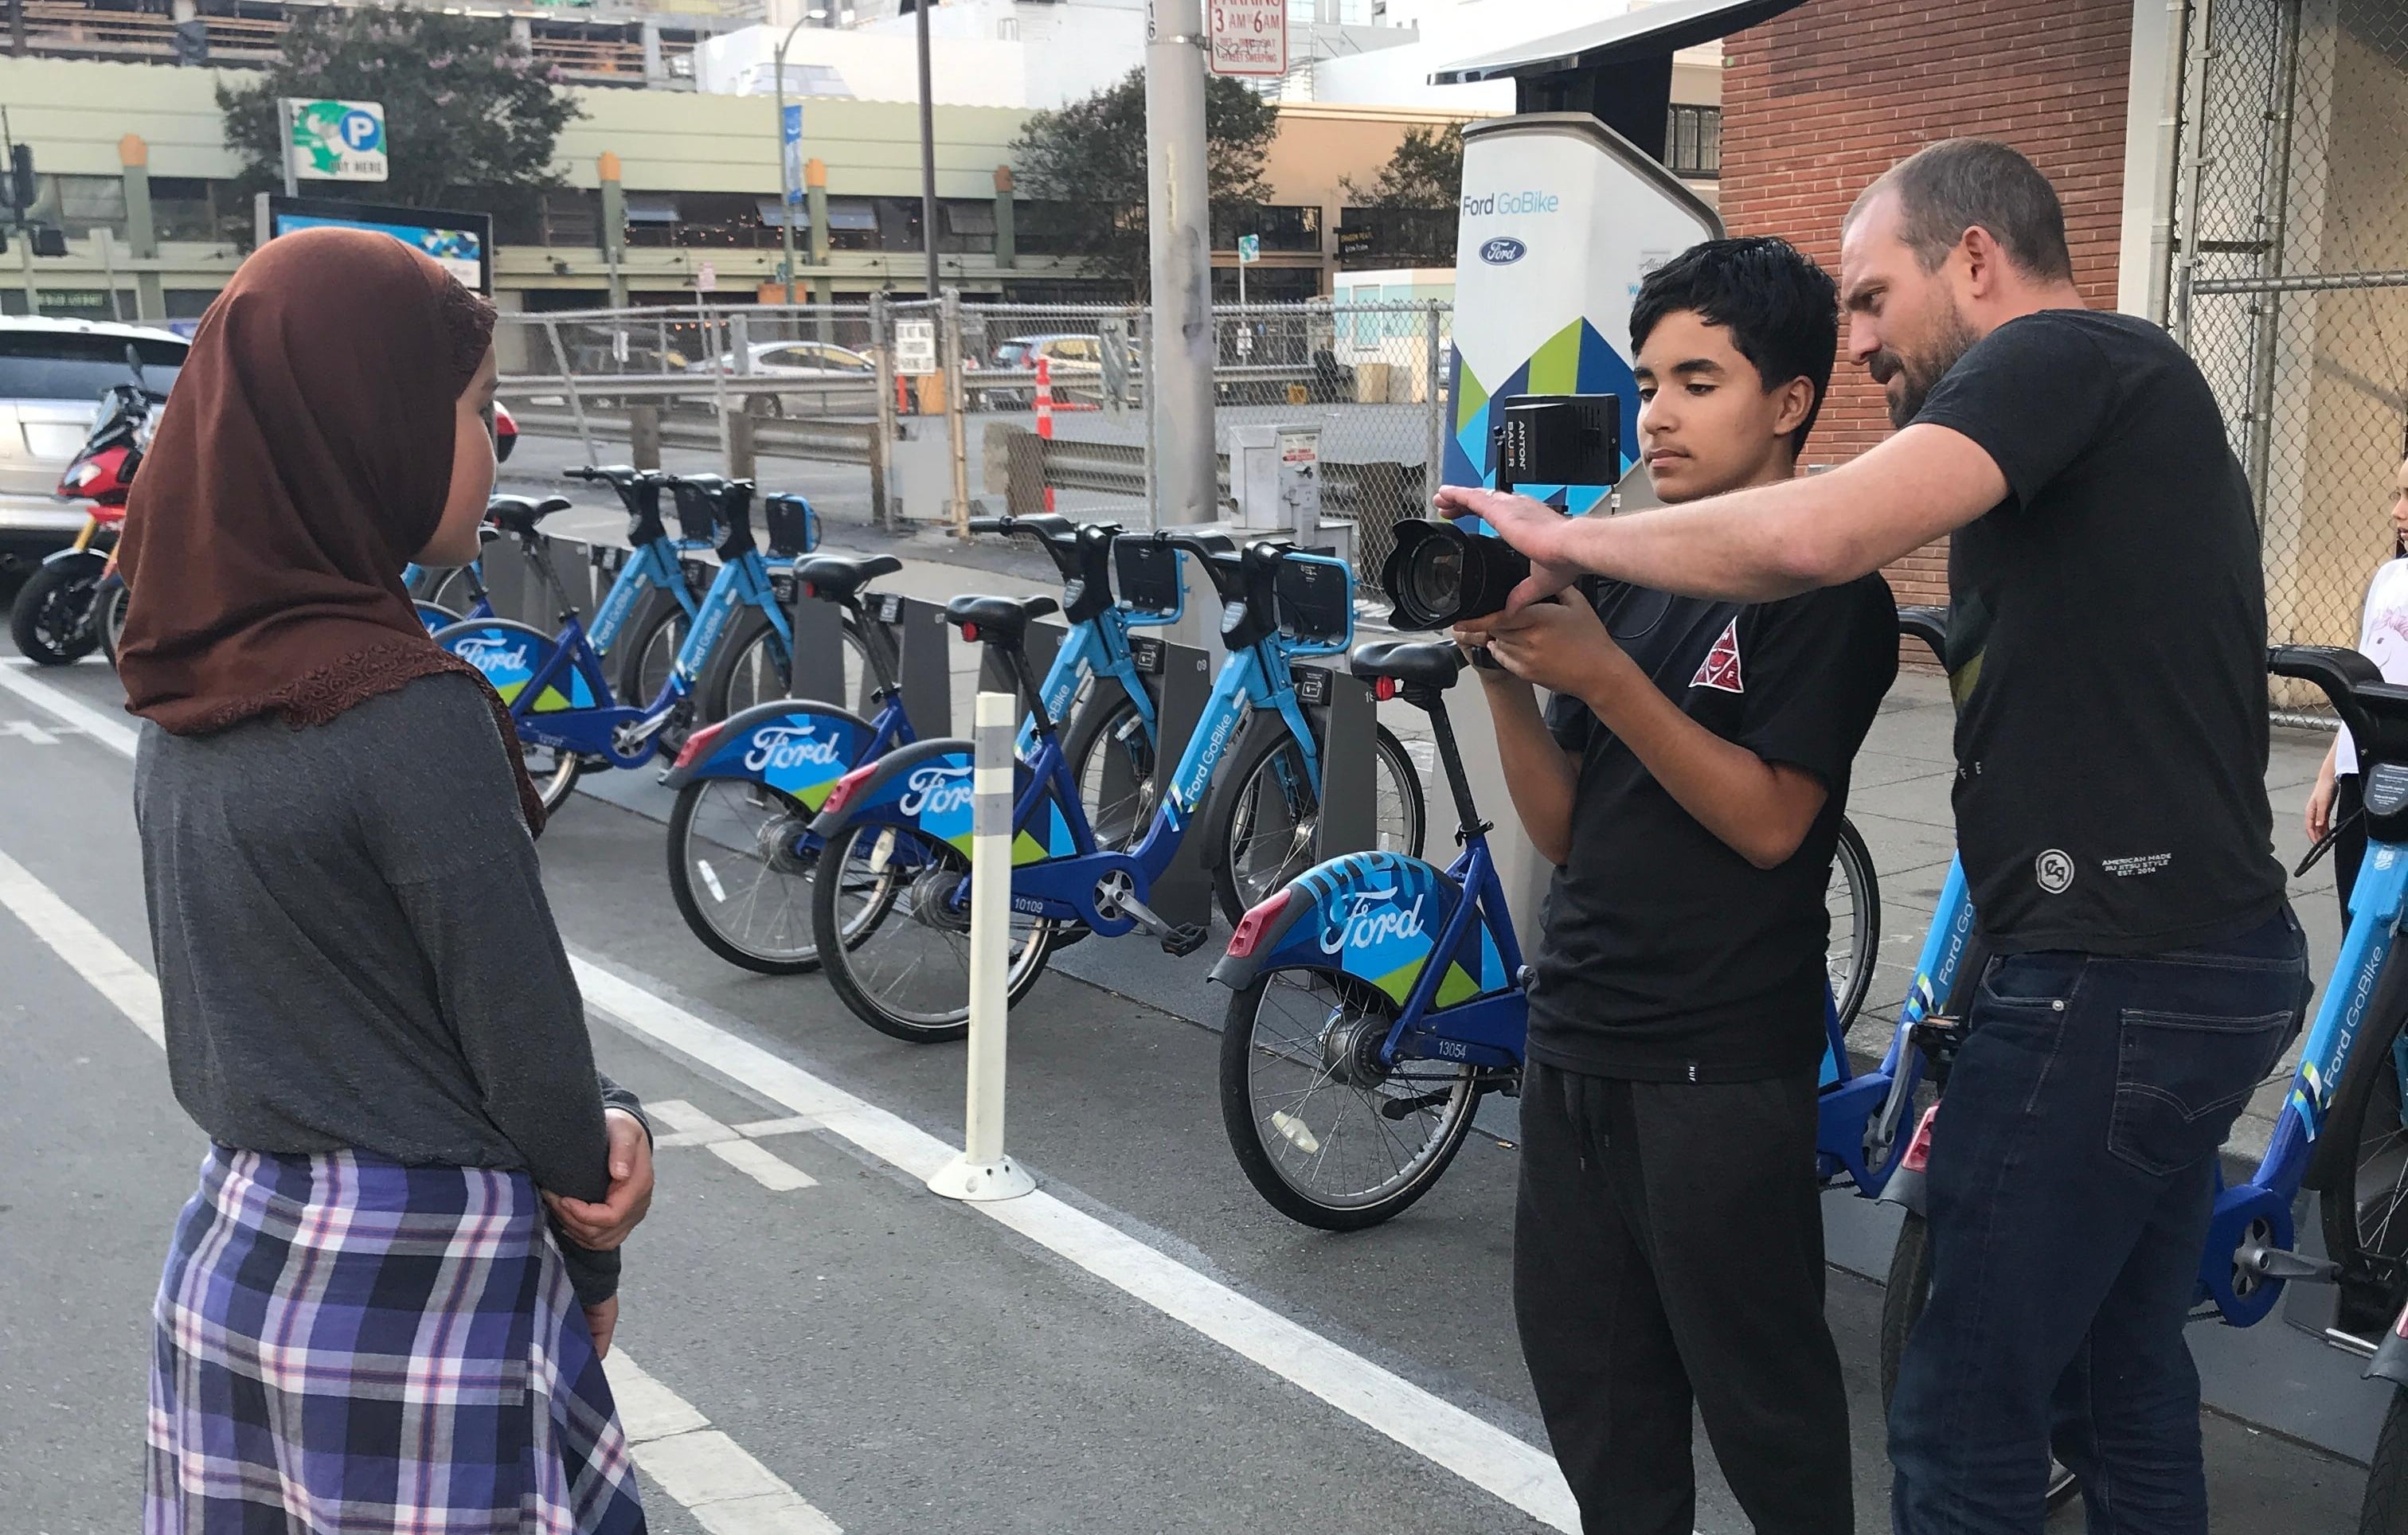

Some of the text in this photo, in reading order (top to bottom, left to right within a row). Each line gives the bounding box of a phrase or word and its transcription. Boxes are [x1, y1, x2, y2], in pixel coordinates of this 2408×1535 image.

[1215, 8, 1225, 33] 3
[1229, 13, 1246, 29] AM
[1254, 10, 1263, 33] 6
[1264, 14, 1280, 29] AM
[348, 116, 375, 146] P
[1463, 190, 1558, 217] Ford GoBike
[1487, 241, 1518, 260] Ford
[455, 638, 527, 671] Ford
[686, 645, 706, 674] Ford
[745, 725, 840, 771] Ford
[1185, 714, 1233, 801] Ford GoBike
[899, 765, 975, 816] For
[2102, 857, 2146, 866] AMERICAN
[2137, 866, 2156, 875] 2014
[2142, 859, 2168, 868] STYLE
[1015, 897, 1044, 914] 10109
[1320, 886, 1424, 955] Ford
[1938, 934, 1962, 986] Ford
[2324, 946, 2384, 1088] Ford GoBike
[1440, 1041, 1467, 1059] 13054
